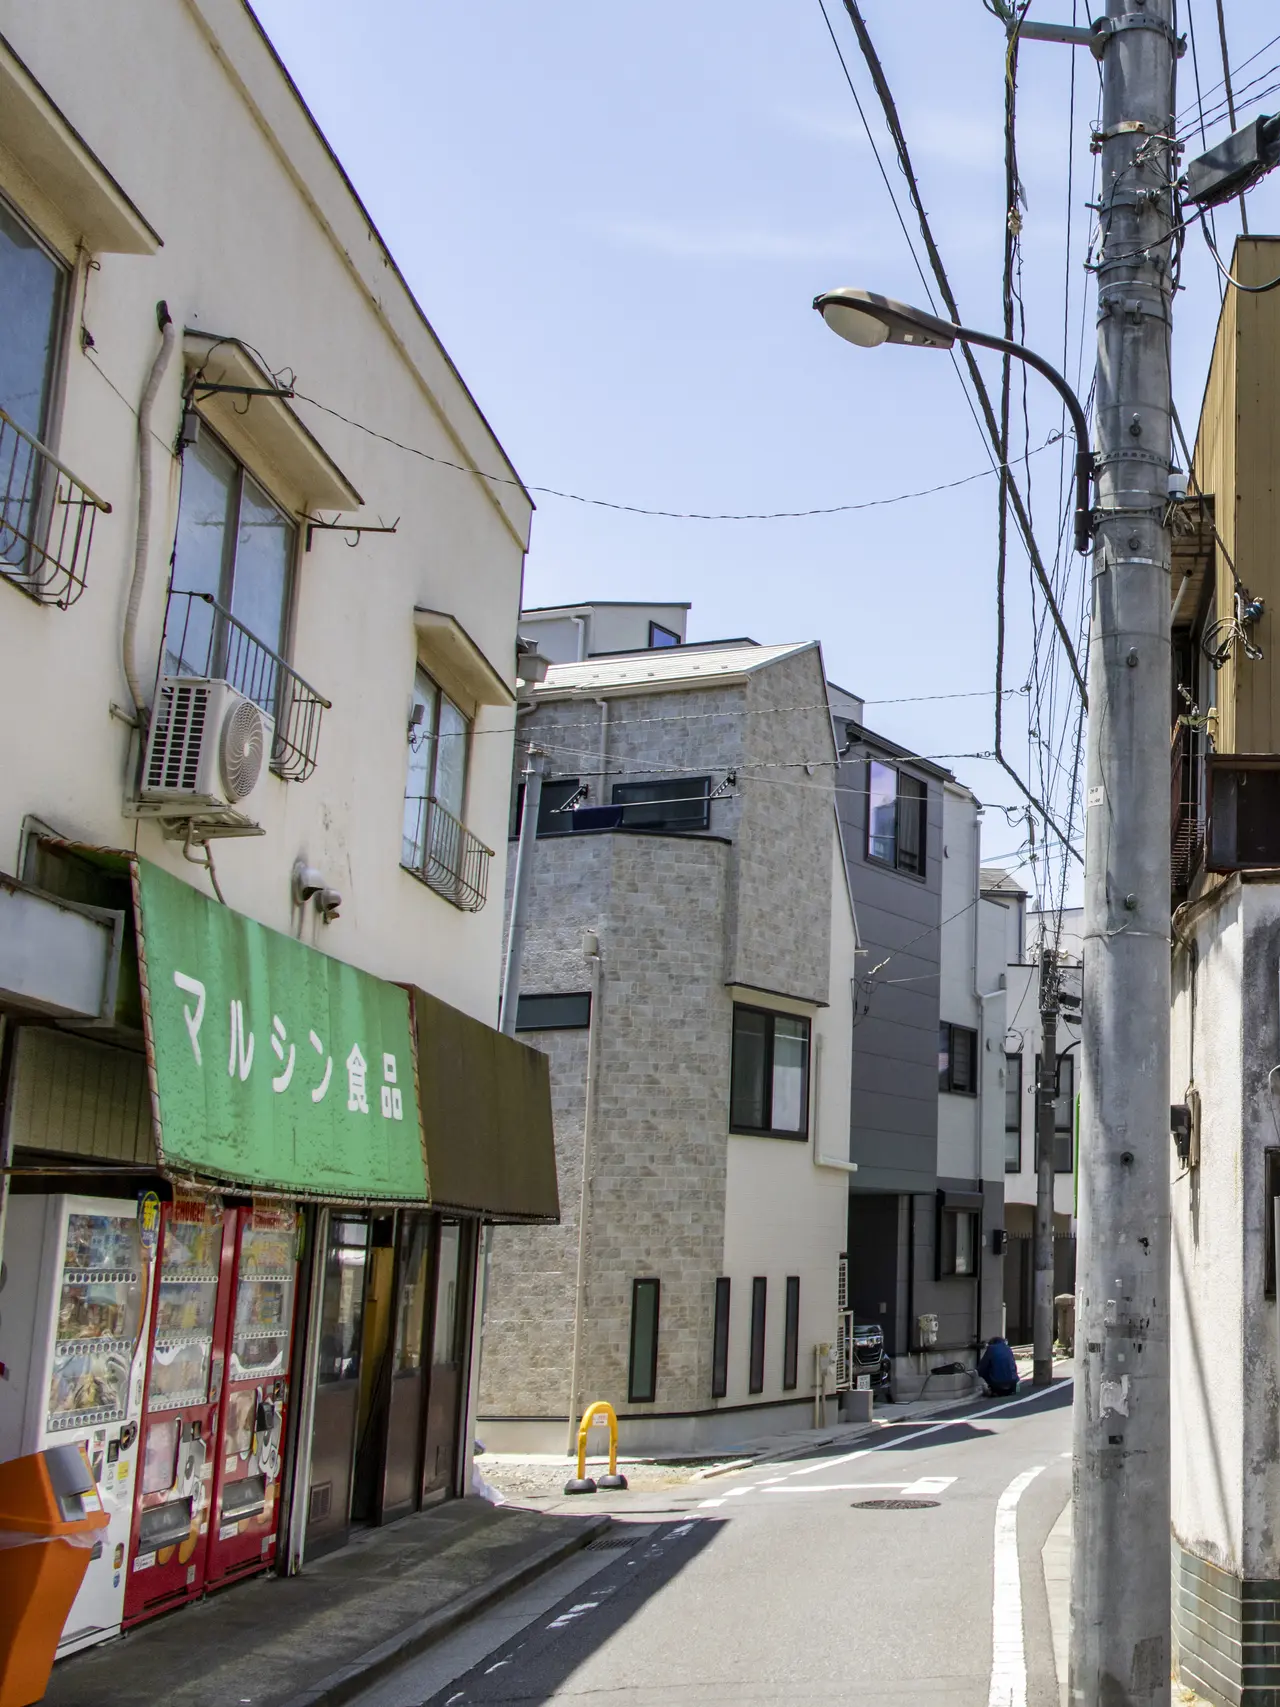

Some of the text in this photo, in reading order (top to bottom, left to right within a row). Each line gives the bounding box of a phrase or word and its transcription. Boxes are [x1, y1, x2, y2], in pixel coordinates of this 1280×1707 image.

[173, 970, 403, 1120] マルシン食品
